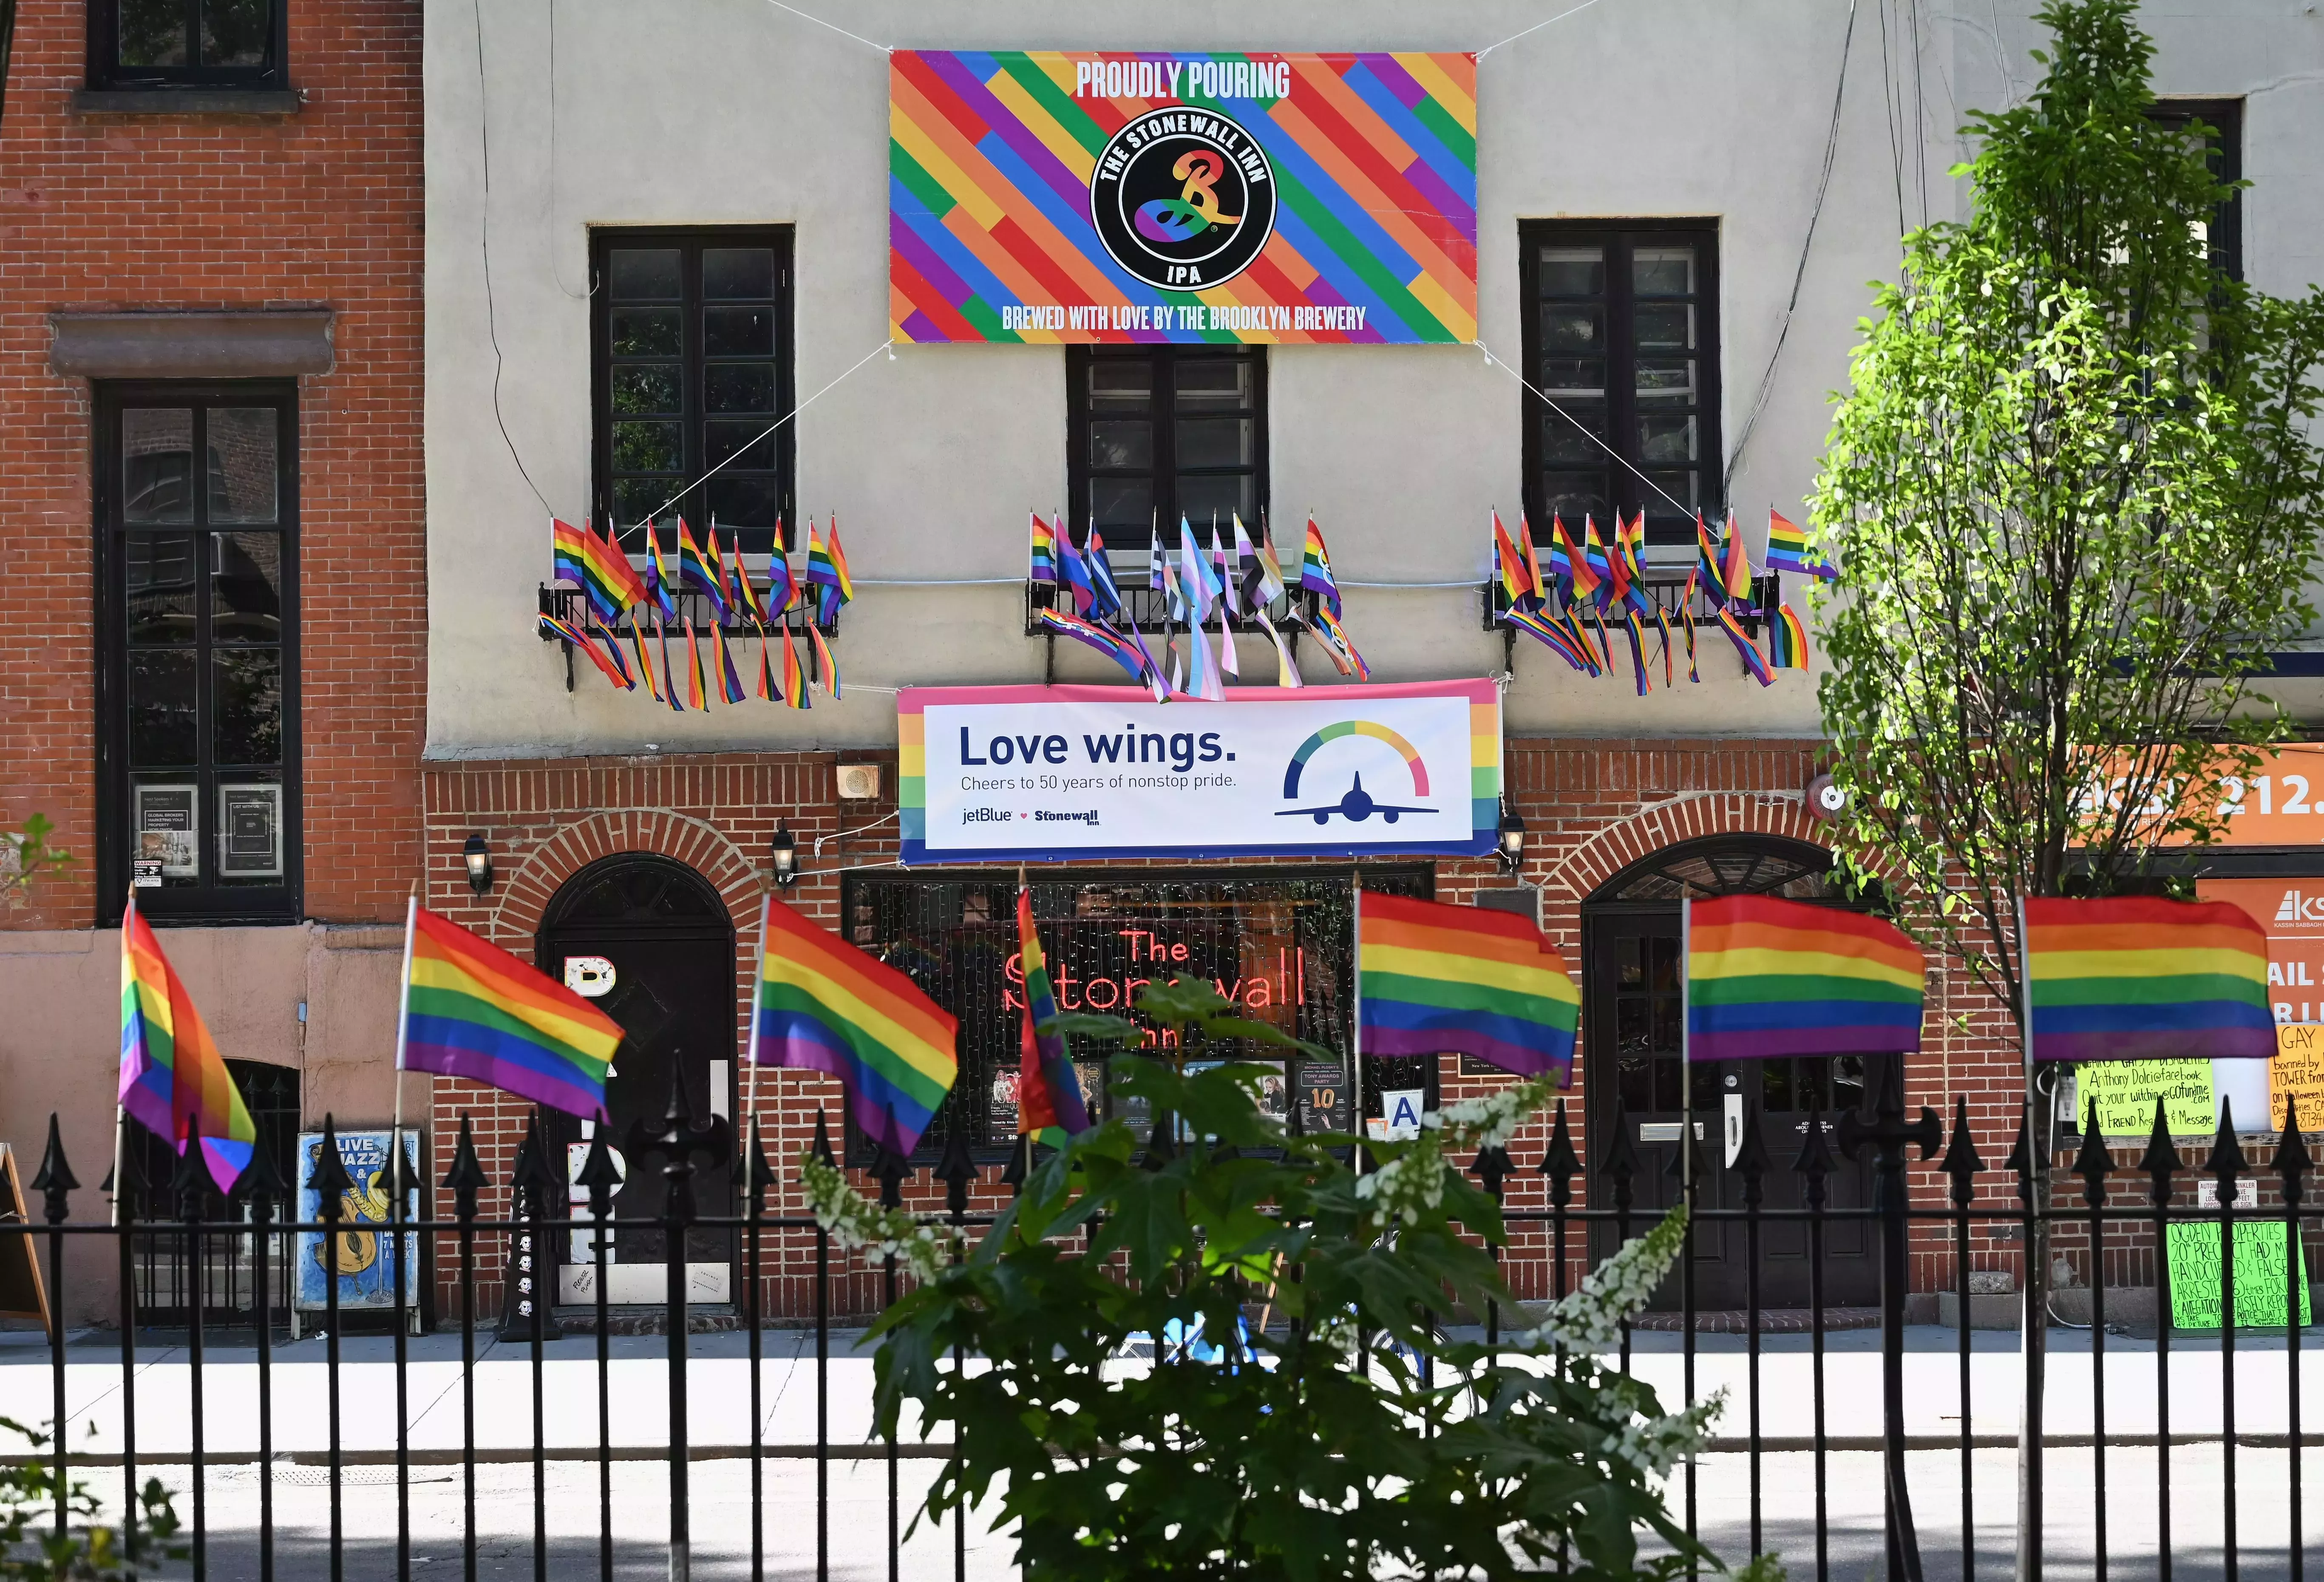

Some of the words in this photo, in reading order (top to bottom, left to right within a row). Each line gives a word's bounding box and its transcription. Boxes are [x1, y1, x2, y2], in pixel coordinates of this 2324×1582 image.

[1077, 61, 1182, 98] PROUDLY
[1188, 61, 1290, 99] POURING
[1100, 145, 1130, 182] THE
[1126, 114, 1240, 150] STONEWALL
[1237, 145, 1267, 184] INN
[1167, 265, 1202, 284] IPA
[1002, 305, 1064, 330] BREWED
[1068, 305, 1108, 330] WITH
[1113, 305, 1150, 330] LOVE
[1153, 305, 1173, 330] BY
[1176, 305, 1206, 330] THE
[1210, 305, 1290, 330] BROOKLYN
[1294, 305, 1367, 330] BREWERY
[961, 726, 1068, 765] Love
[1083, 723, 1236, 772] wings.
[961, 776, 1015, 791] Cheers
[1020, 776, 1034, 789] to
[1040, 776, 1057, 789] 50
[1063, 777, 1104, 792] years
[1109, 774, 1123, 789] of
[1128, 774, 1188, 790] nonstop
[1194, 773, 1237, 788] pride.
[962, 808, 1013, 825] jetBlue
[1034, 810, 1098, 821] Stonewall
[1119, 930, 1189, 961] The
[2267, 962, 2314, 986] AIL
[2281, 1026, 2315, 1049] GAY
[2274, 1054, 2306, 1070] banned
[2308, 1054, 2319, 1071] by
[2090, 1068, 2129, 1089] Anthony
[2273, 1070, 2307, 1087] TOWER
[1311, 1088, 1335, 1109] 10
[2106, 1092, 2127, 1106] your
[2273, 1093, 2283, 1103] on
[1392, 1097, 1418, 1127] A
[2107, 1110, 2136, 1128] FRIEND
[2179, 1109, 2213, 1127] Message
[336, 1139, 374, 1152] LIVE
[357, 1168, 366, 1179] &
[2171, 1224, 2211, 1242] OGDEN
[2216, 1222, 2281, 1242] POPERTIES
[383, 1240, 388, 1249] 7
[2250, 1242, 2270, 1259] HAD
[385, 1250, 389, 1259] A
[2177, 1279, 2222, 1300] ARRESTE
[2264, 1278, 2285, 1294] FOR
[2237, 1310, 2258, 1319] POLICE
[2259, 1309, 2276, 1318] THAT
